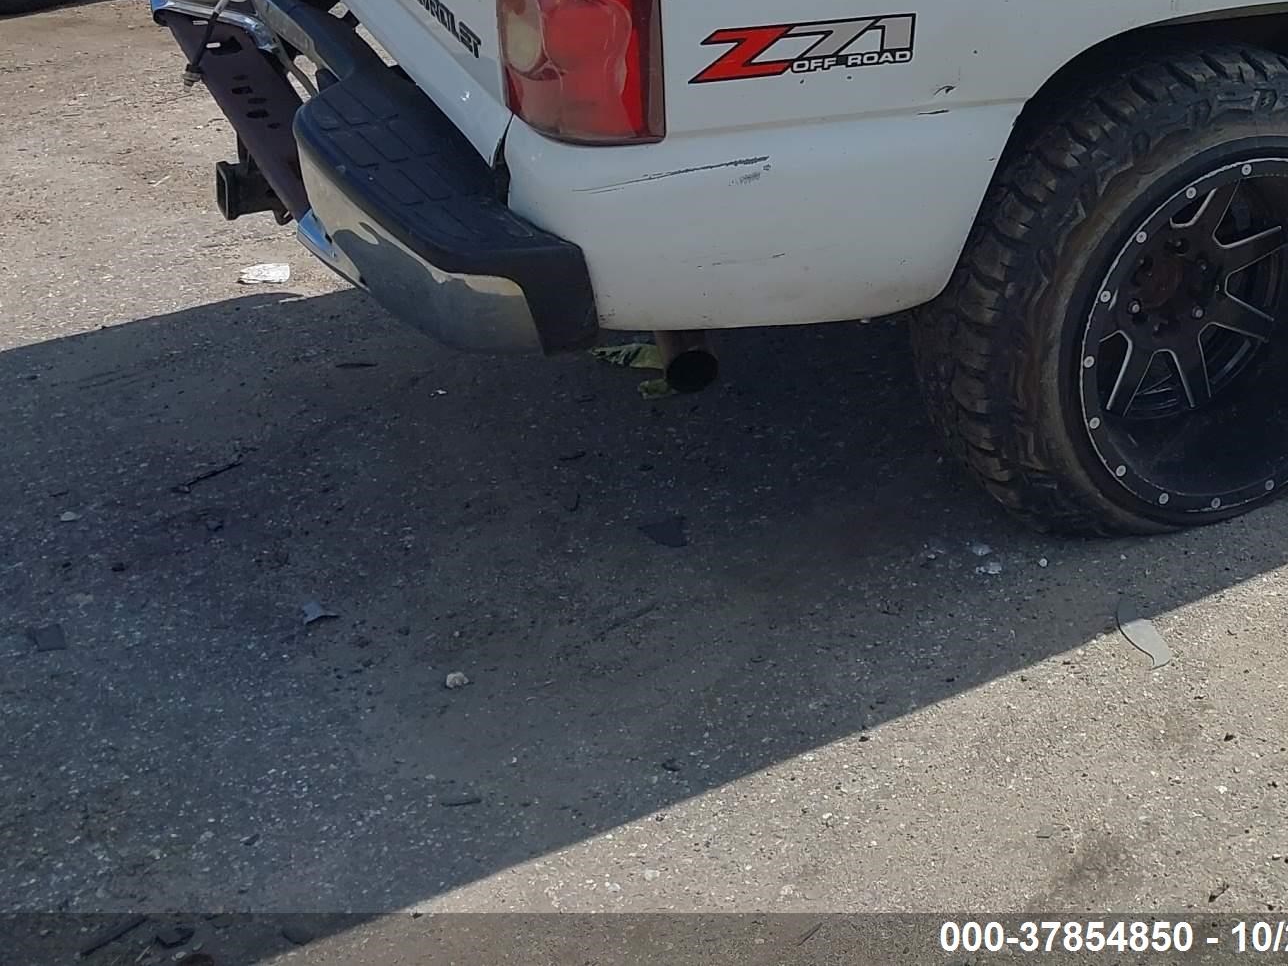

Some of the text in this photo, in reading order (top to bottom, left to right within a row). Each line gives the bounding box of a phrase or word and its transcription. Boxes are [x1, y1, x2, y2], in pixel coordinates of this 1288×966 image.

[688, 13, 916, 84] Z71
[792, 50, 912, 72] OFF ROAD
